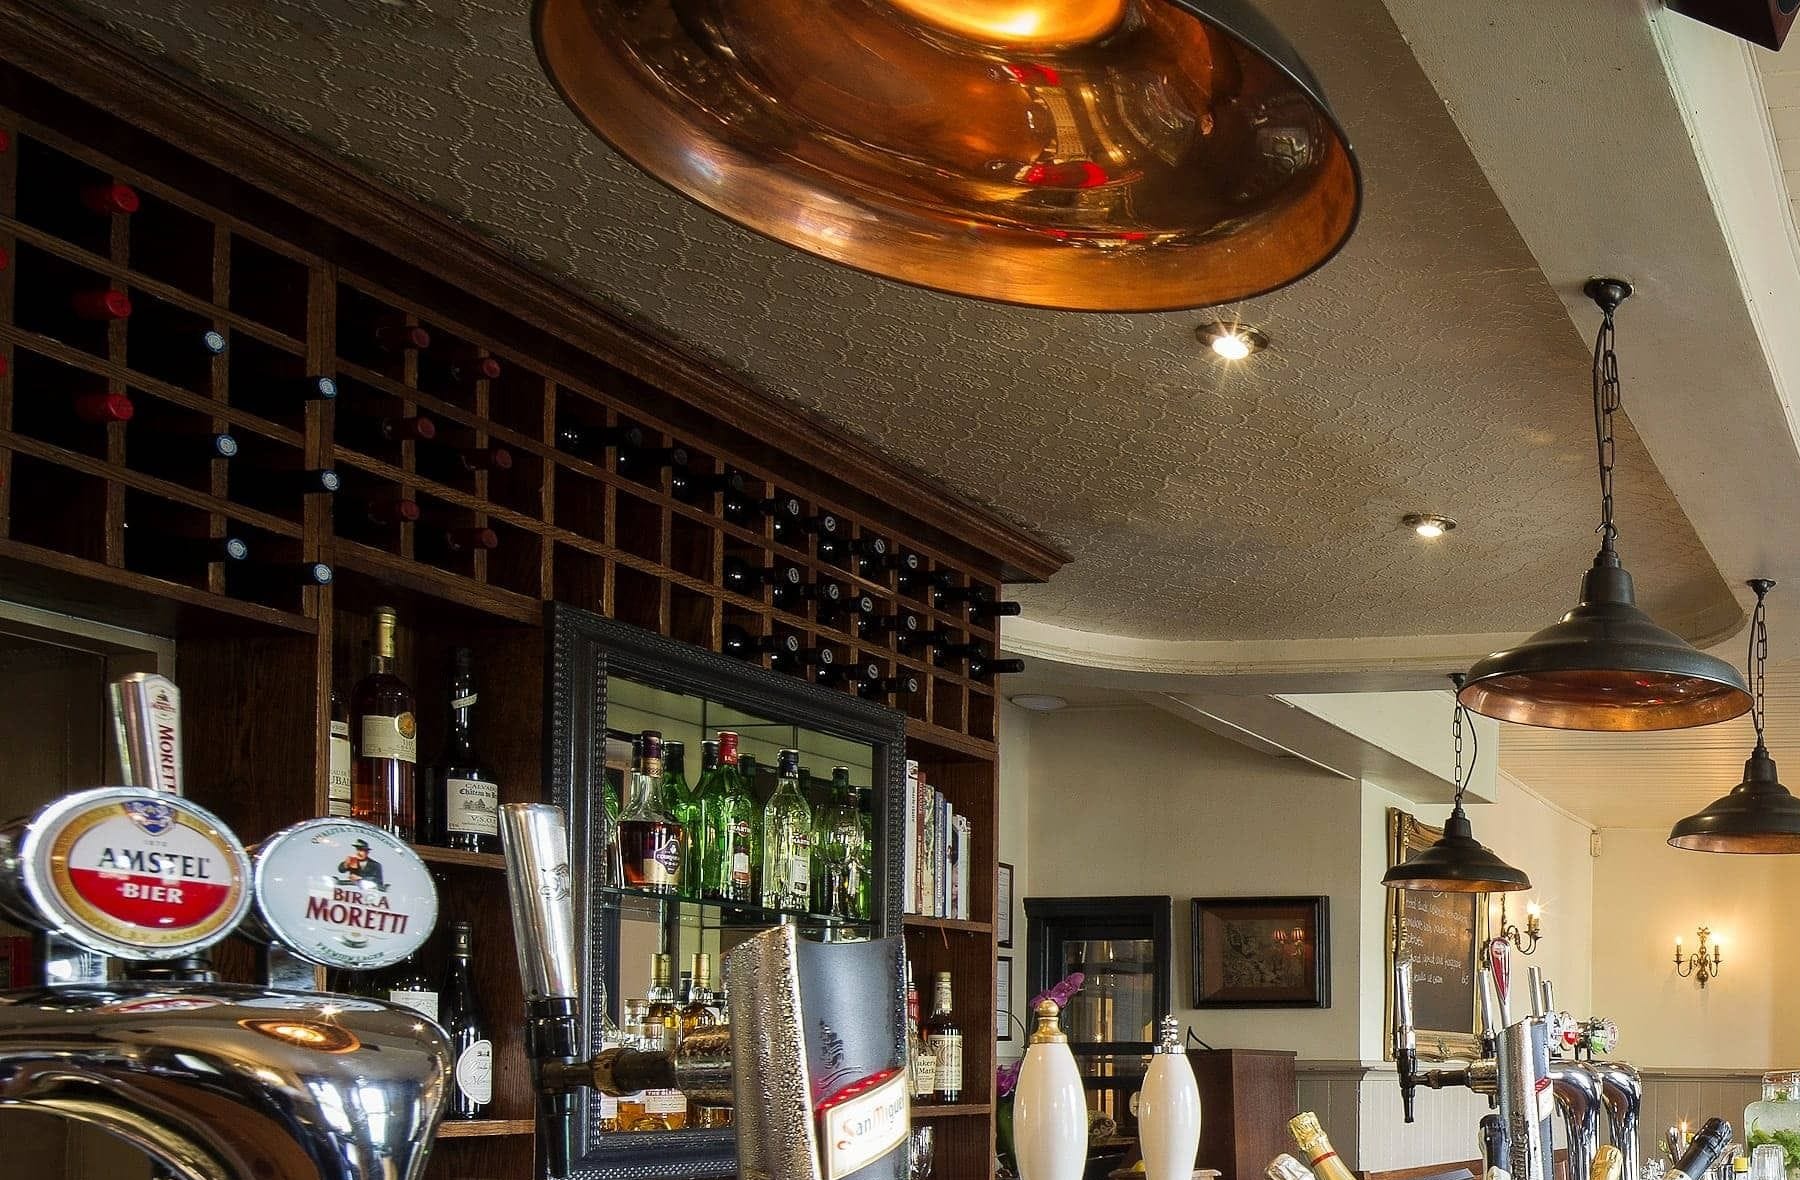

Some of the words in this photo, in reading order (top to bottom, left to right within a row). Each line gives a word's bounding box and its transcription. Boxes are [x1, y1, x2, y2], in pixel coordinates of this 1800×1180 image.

[98, 847, 210, 879] AMSTEL
[122, 882, 184, 904] BIER
[333, 886, 390, 910] BIRA
[305, 895, 409, 935] MORETTI
